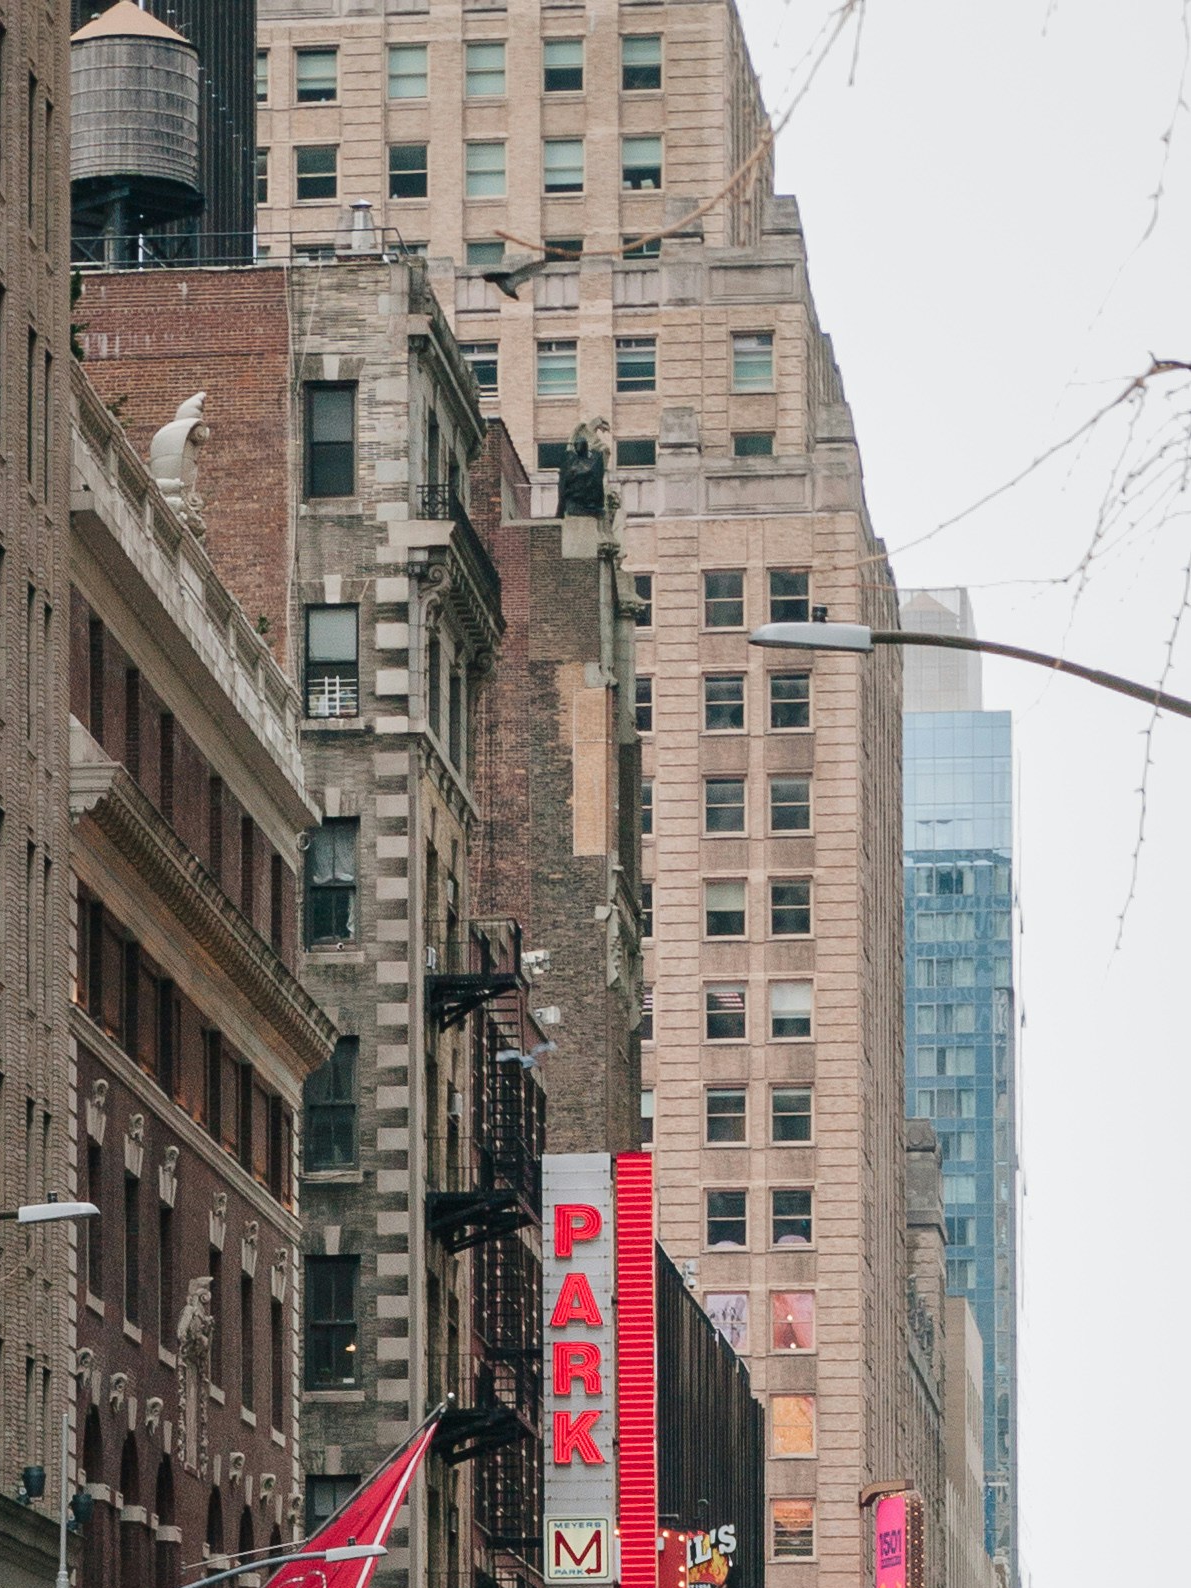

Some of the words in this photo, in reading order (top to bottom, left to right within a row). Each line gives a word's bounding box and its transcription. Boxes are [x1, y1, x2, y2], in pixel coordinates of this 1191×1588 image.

[550, 1204, 606, 1465] PARK
[554, 1521, 602, 1529] MEYERS
[554, 1568, 585, 1576] PARK
